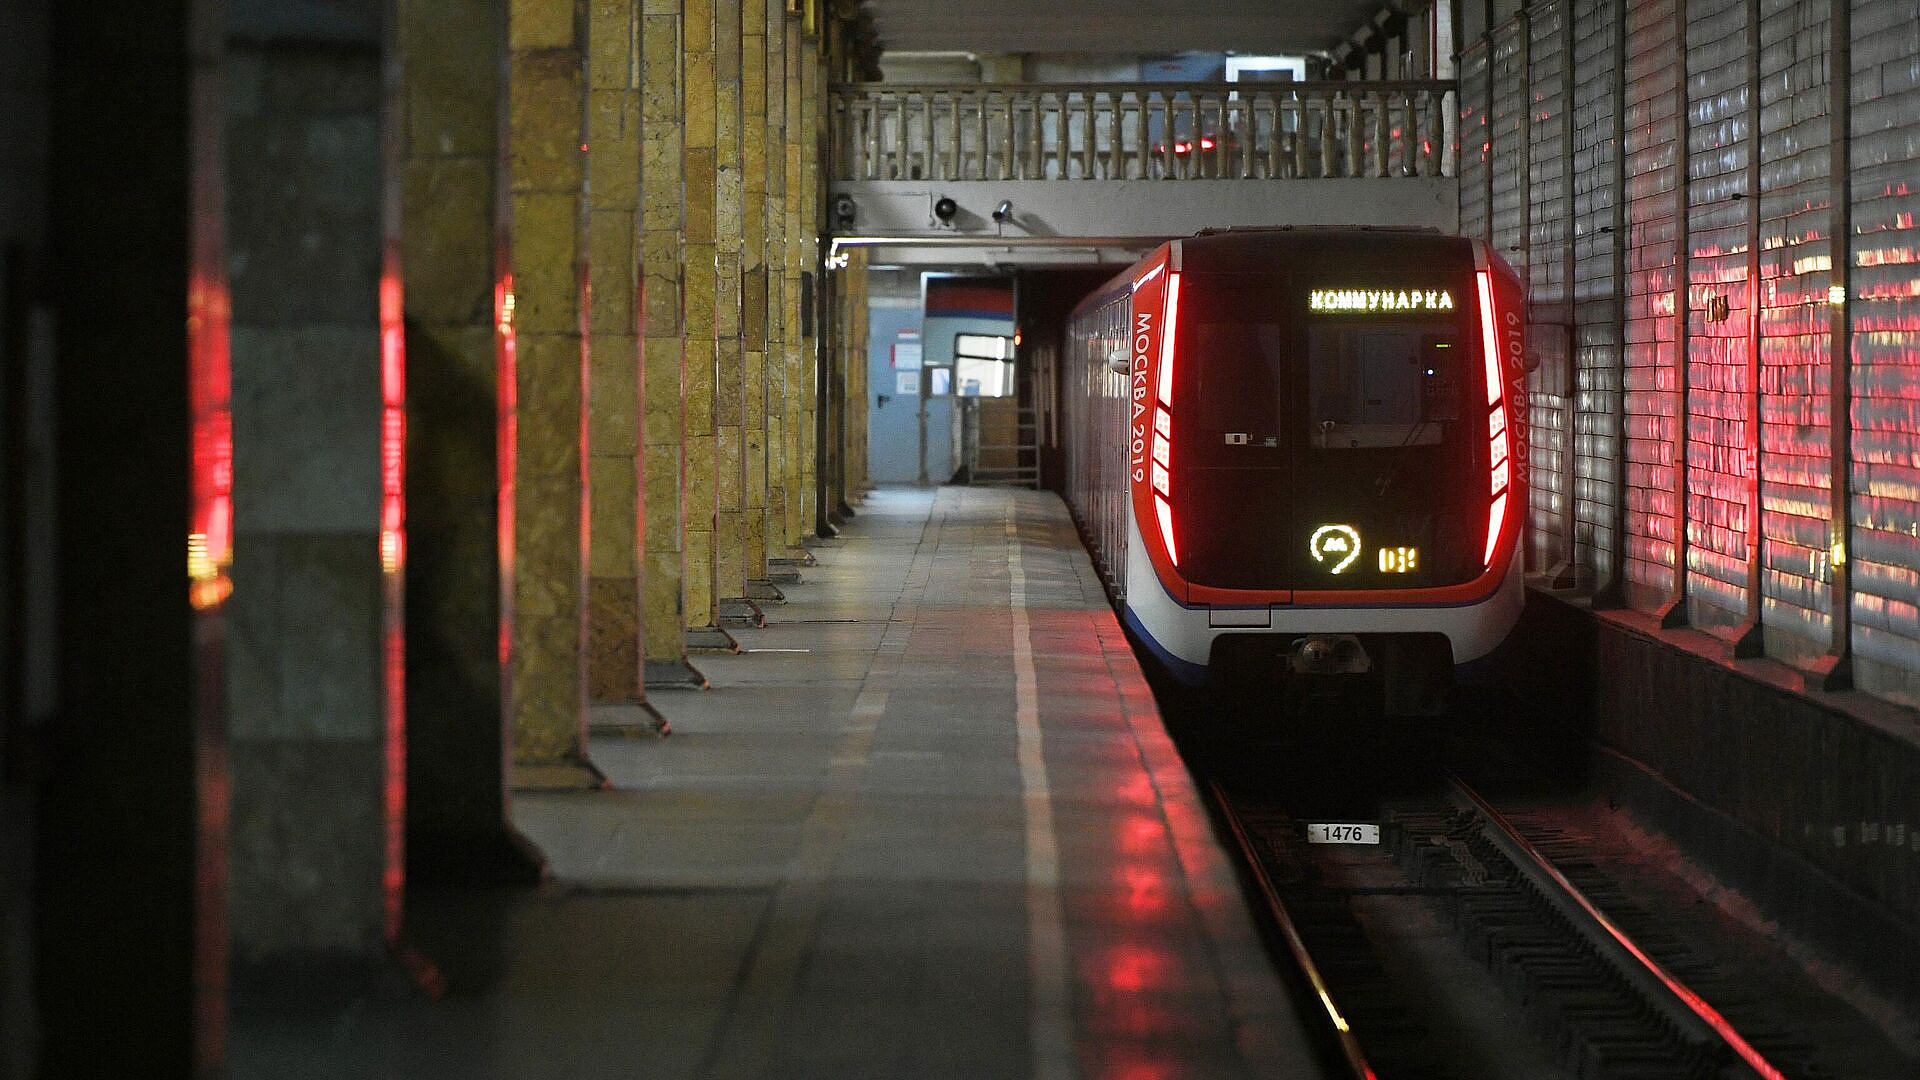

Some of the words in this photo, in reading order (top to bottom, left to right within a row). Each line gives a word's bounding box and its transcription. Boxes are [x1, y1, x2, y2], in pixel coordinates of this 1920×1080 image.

[1310, 289, 1453, 309] КОММУНАРКА
[1132, 313, 1152, 420] МОСКВА
[1506, 311, 1523, 369] 2019
[1132, 423, 1145, 483] 2019
[1512, 376, 1528, 483] МОСКВА
[1322, 826, 1362, 841] 1476
